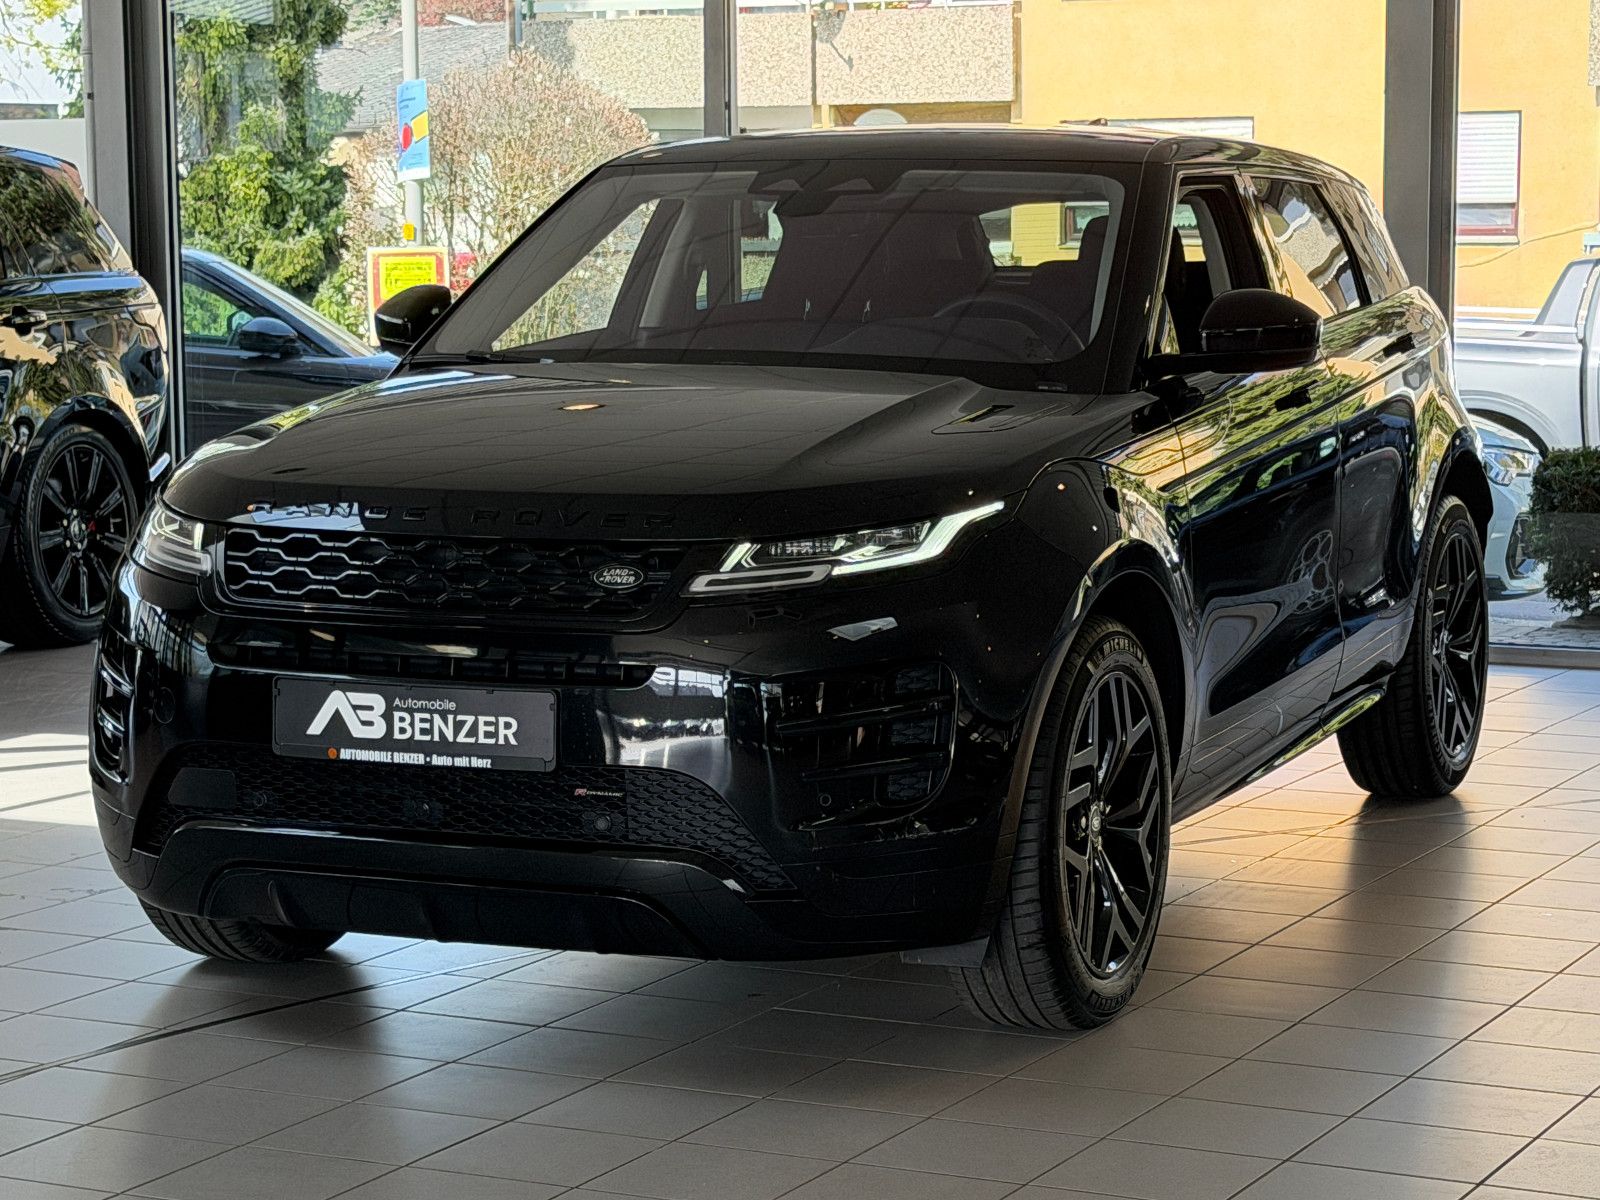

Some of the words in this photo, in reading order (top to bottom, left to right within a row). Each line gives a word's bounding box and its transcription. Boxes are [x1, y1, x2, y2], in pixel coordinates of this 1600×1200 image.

[248, 502, 429, 521] RANGE
[470, 508, 678, 528] ROVER
[1104, 637, 1142, 661] MICHELIN
[393, 697, 457, 711] Automobile
[393, 712, 518, 745] BENZER
[340, 749, 392, 763] AUTOMOBILE
[393, 753, 425, 765] BENZER
[432, 754, 452, 767] Auto
[454, 757, 469, 769] mit
[471, 757, 492, 769] Herz
